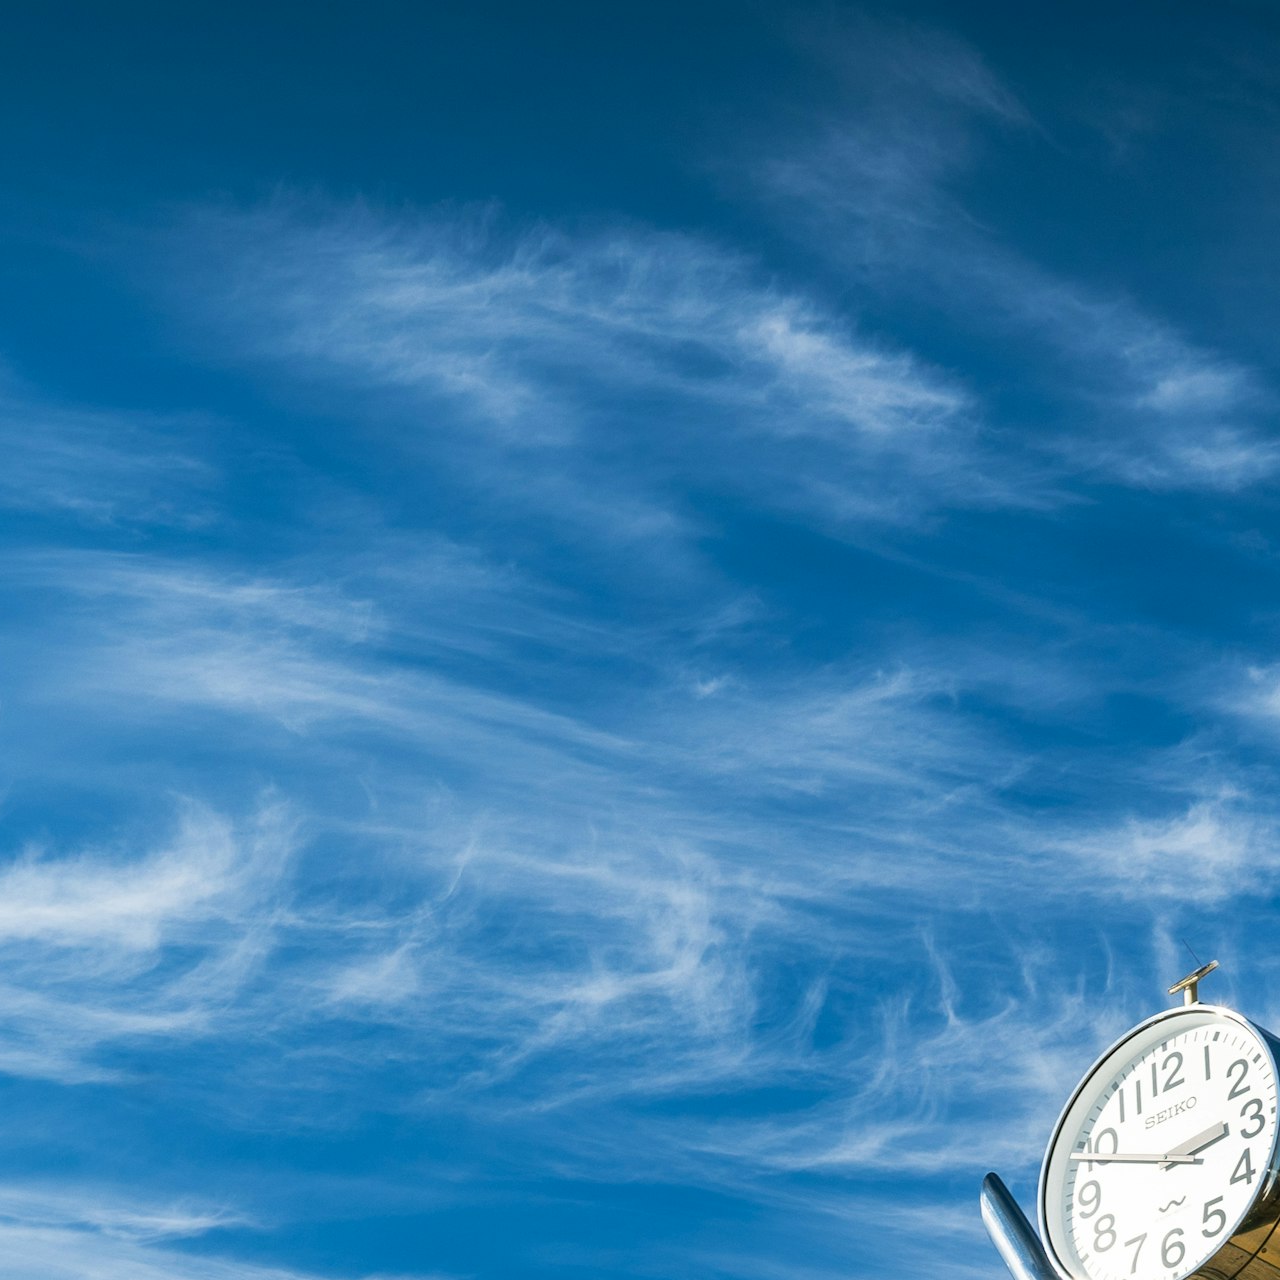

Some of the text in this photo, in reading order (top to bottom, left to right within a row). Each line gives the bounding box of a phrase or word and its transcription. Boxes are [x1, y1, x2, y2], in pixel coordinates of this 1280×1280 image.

[1151, 1052, 1184, 1097] 12
[1204, 1045, 1210, 1080] 1
[1226, 1059, 1250, 1101] 2
[1119, 1080, 1142, 1123] 11
[1145, 1096, 1197, 1130] SEIKO
[1240, 1099, 1265, 1139] 3
[1087, 1128, 1118, 1171] 10
[1230, 1148, 1256, 1185] 4
[1078, 1180, 1101, 1219] 9
[1202, 1196, 1226, 1238] 5
[1093, 1214, 1116, 1253] 8
[1125, 1233, 1147, 1274] 7
[1161, 1228, 1185, 1268] 6
